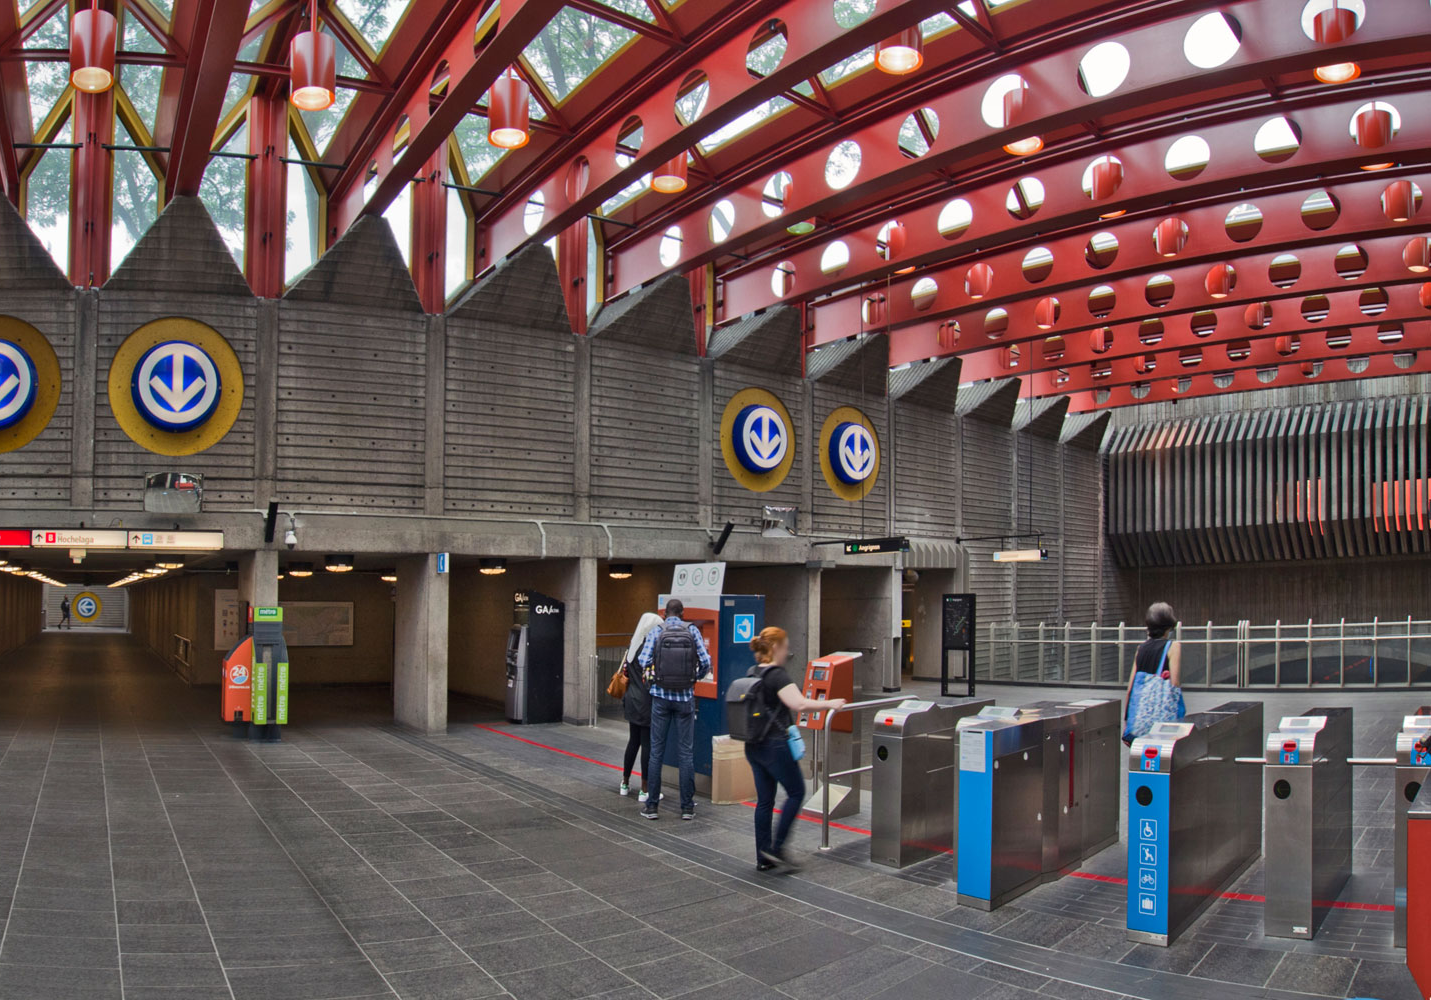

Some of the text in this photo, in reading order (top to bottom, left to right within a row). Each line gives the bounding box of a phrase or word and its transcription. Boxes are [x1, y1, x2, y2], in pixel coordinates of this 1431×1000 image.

[57, 535, 94, 544] Hochelaga
[232, 665, 245, 677] 24
[257, 666, 265, 691] métro
[279, 666, 287, 691] métro
[256, 695, 265, 721] métro
[278, 695, 286, 721] métro
